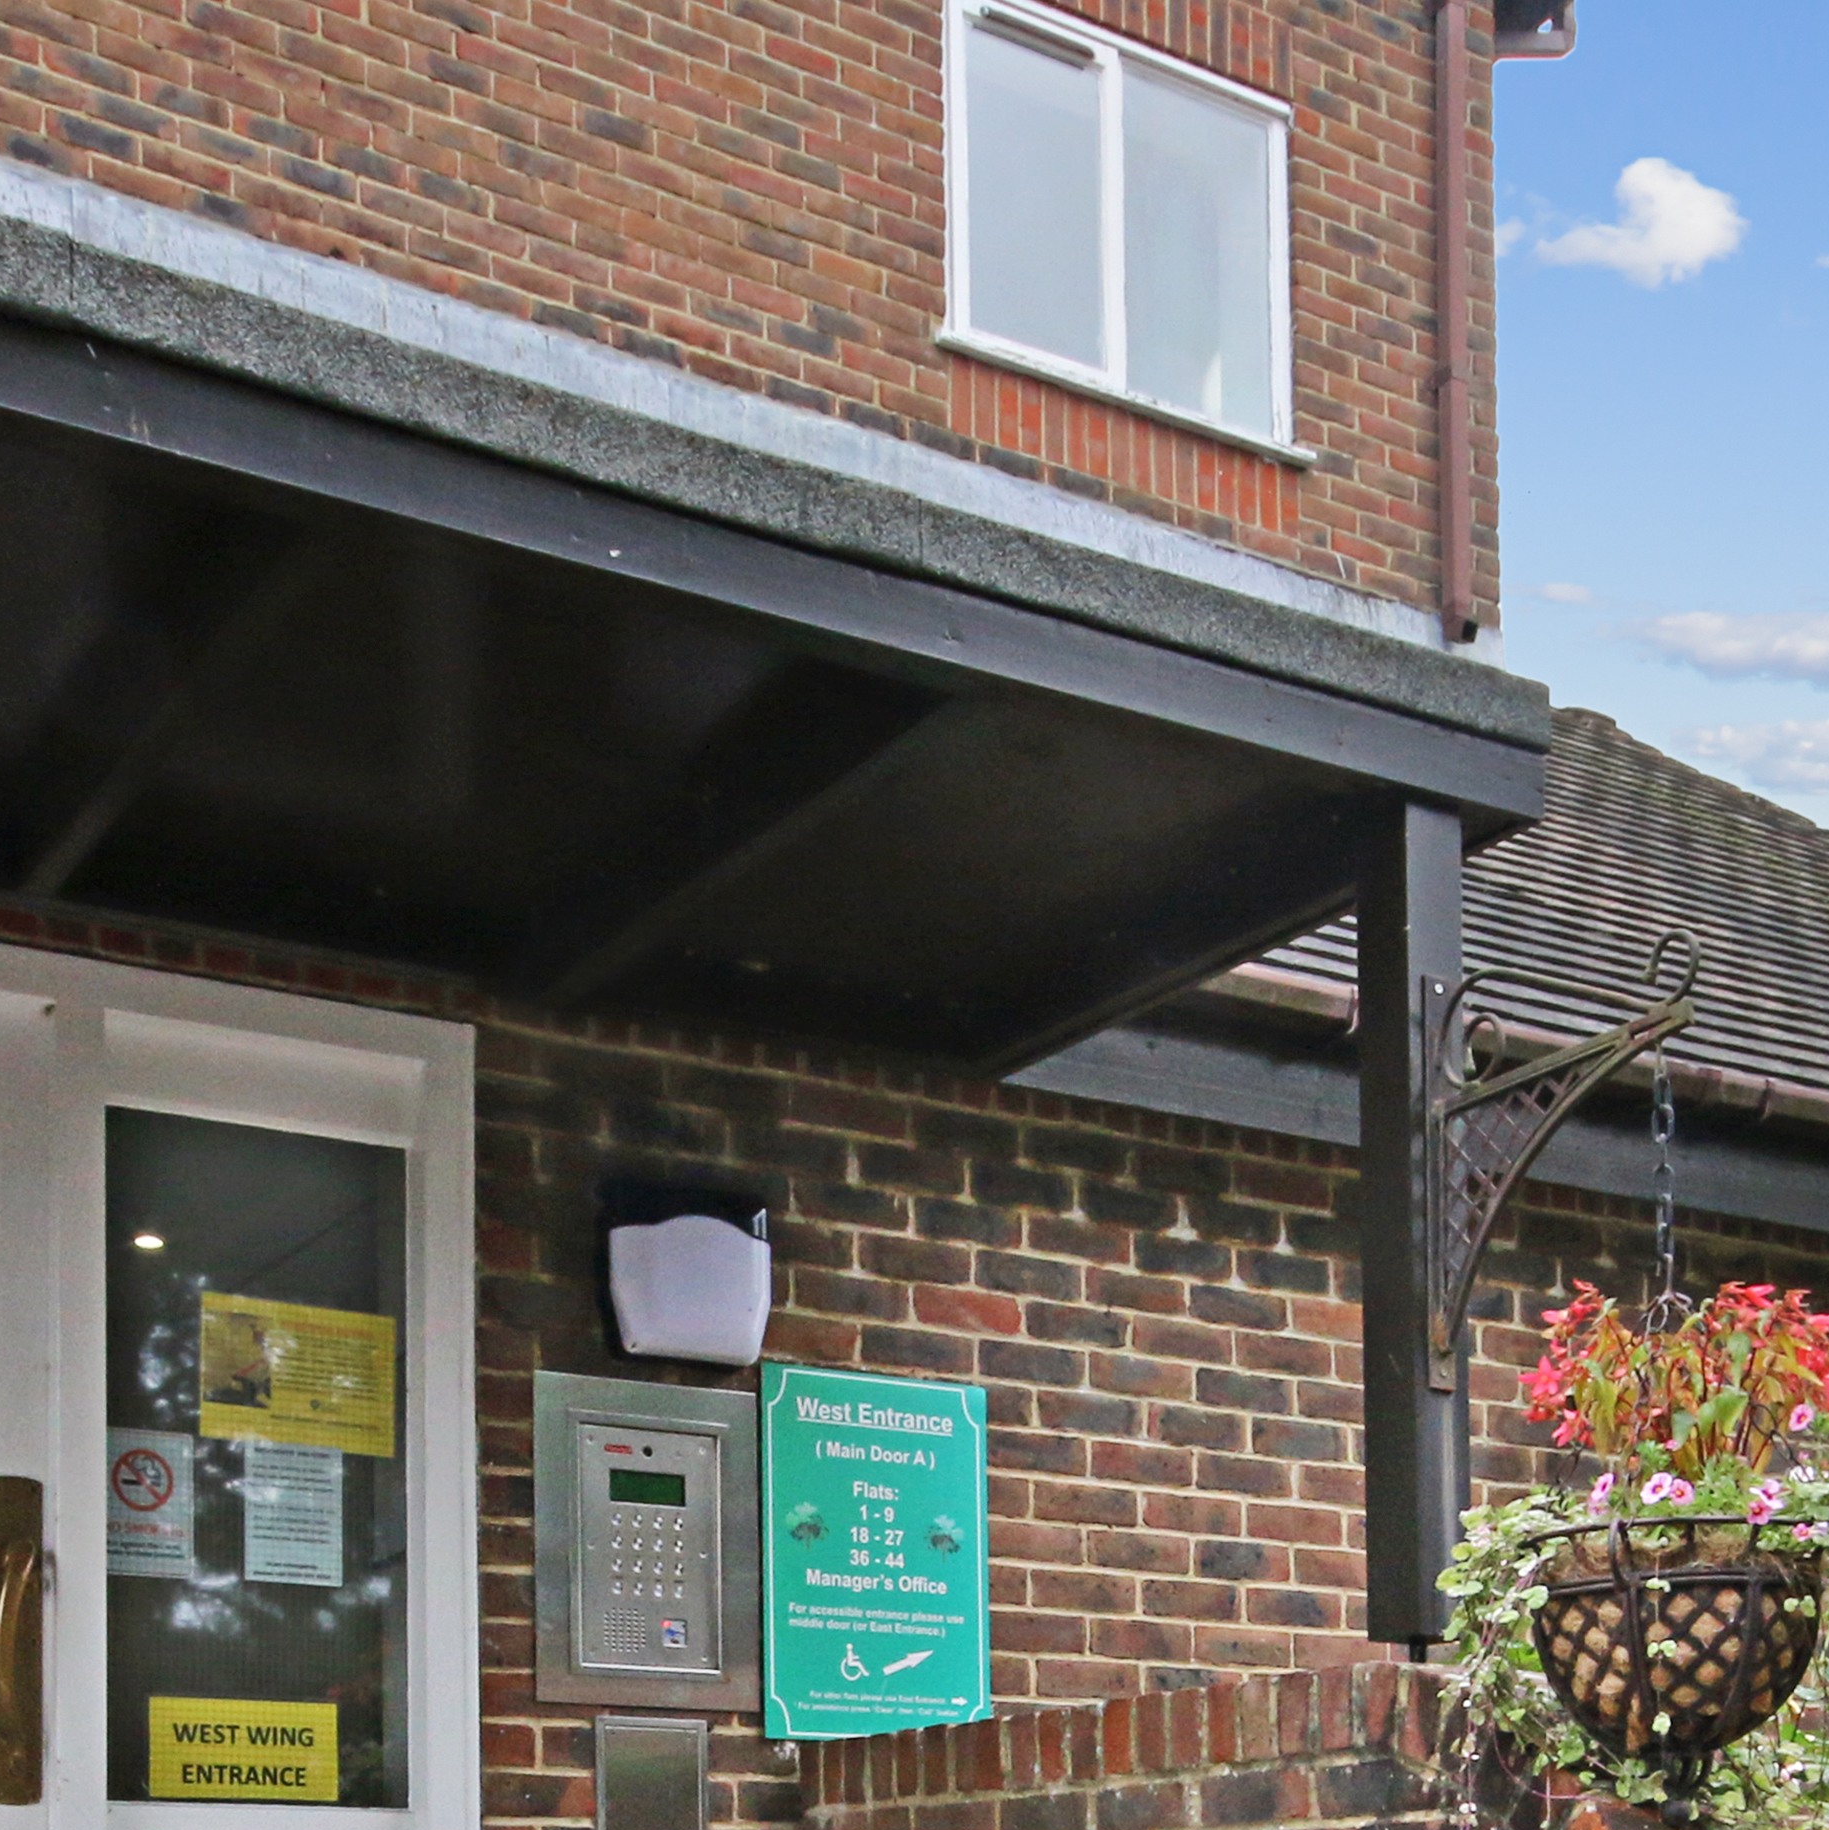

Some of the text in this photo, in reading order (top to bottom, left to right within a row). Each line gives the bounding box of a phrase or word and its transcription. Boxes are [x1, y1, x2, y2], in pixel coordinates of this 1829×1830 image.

[796, 1396, 953, 1433] West Entrance
[826, 1441, 865, 1460] Main
[870, 1445, 911, 1464] Door
[913, 1450, 926, 1466] A
[852, 1480, 900, 1501] Flats:
[850, 1526, 870, 1544] 18
[884, 1529, 905, 1546] 27
[849, 1548, 870, 1566] 36
[884, 1552, 905, 1569] 44
[805, 1568, 948, 1595] Manager's Office
[789, 1602, 965, 1624] For accessible entrance please use
[789, 1617, 824, 1629] middle
[826, 1619, 851, 1630] door
[870, 1621, 892, 1633] East
[173, 1723, 315, 1747] WEST WING
[181, 1764, 307, 1787] ENTRANCE
